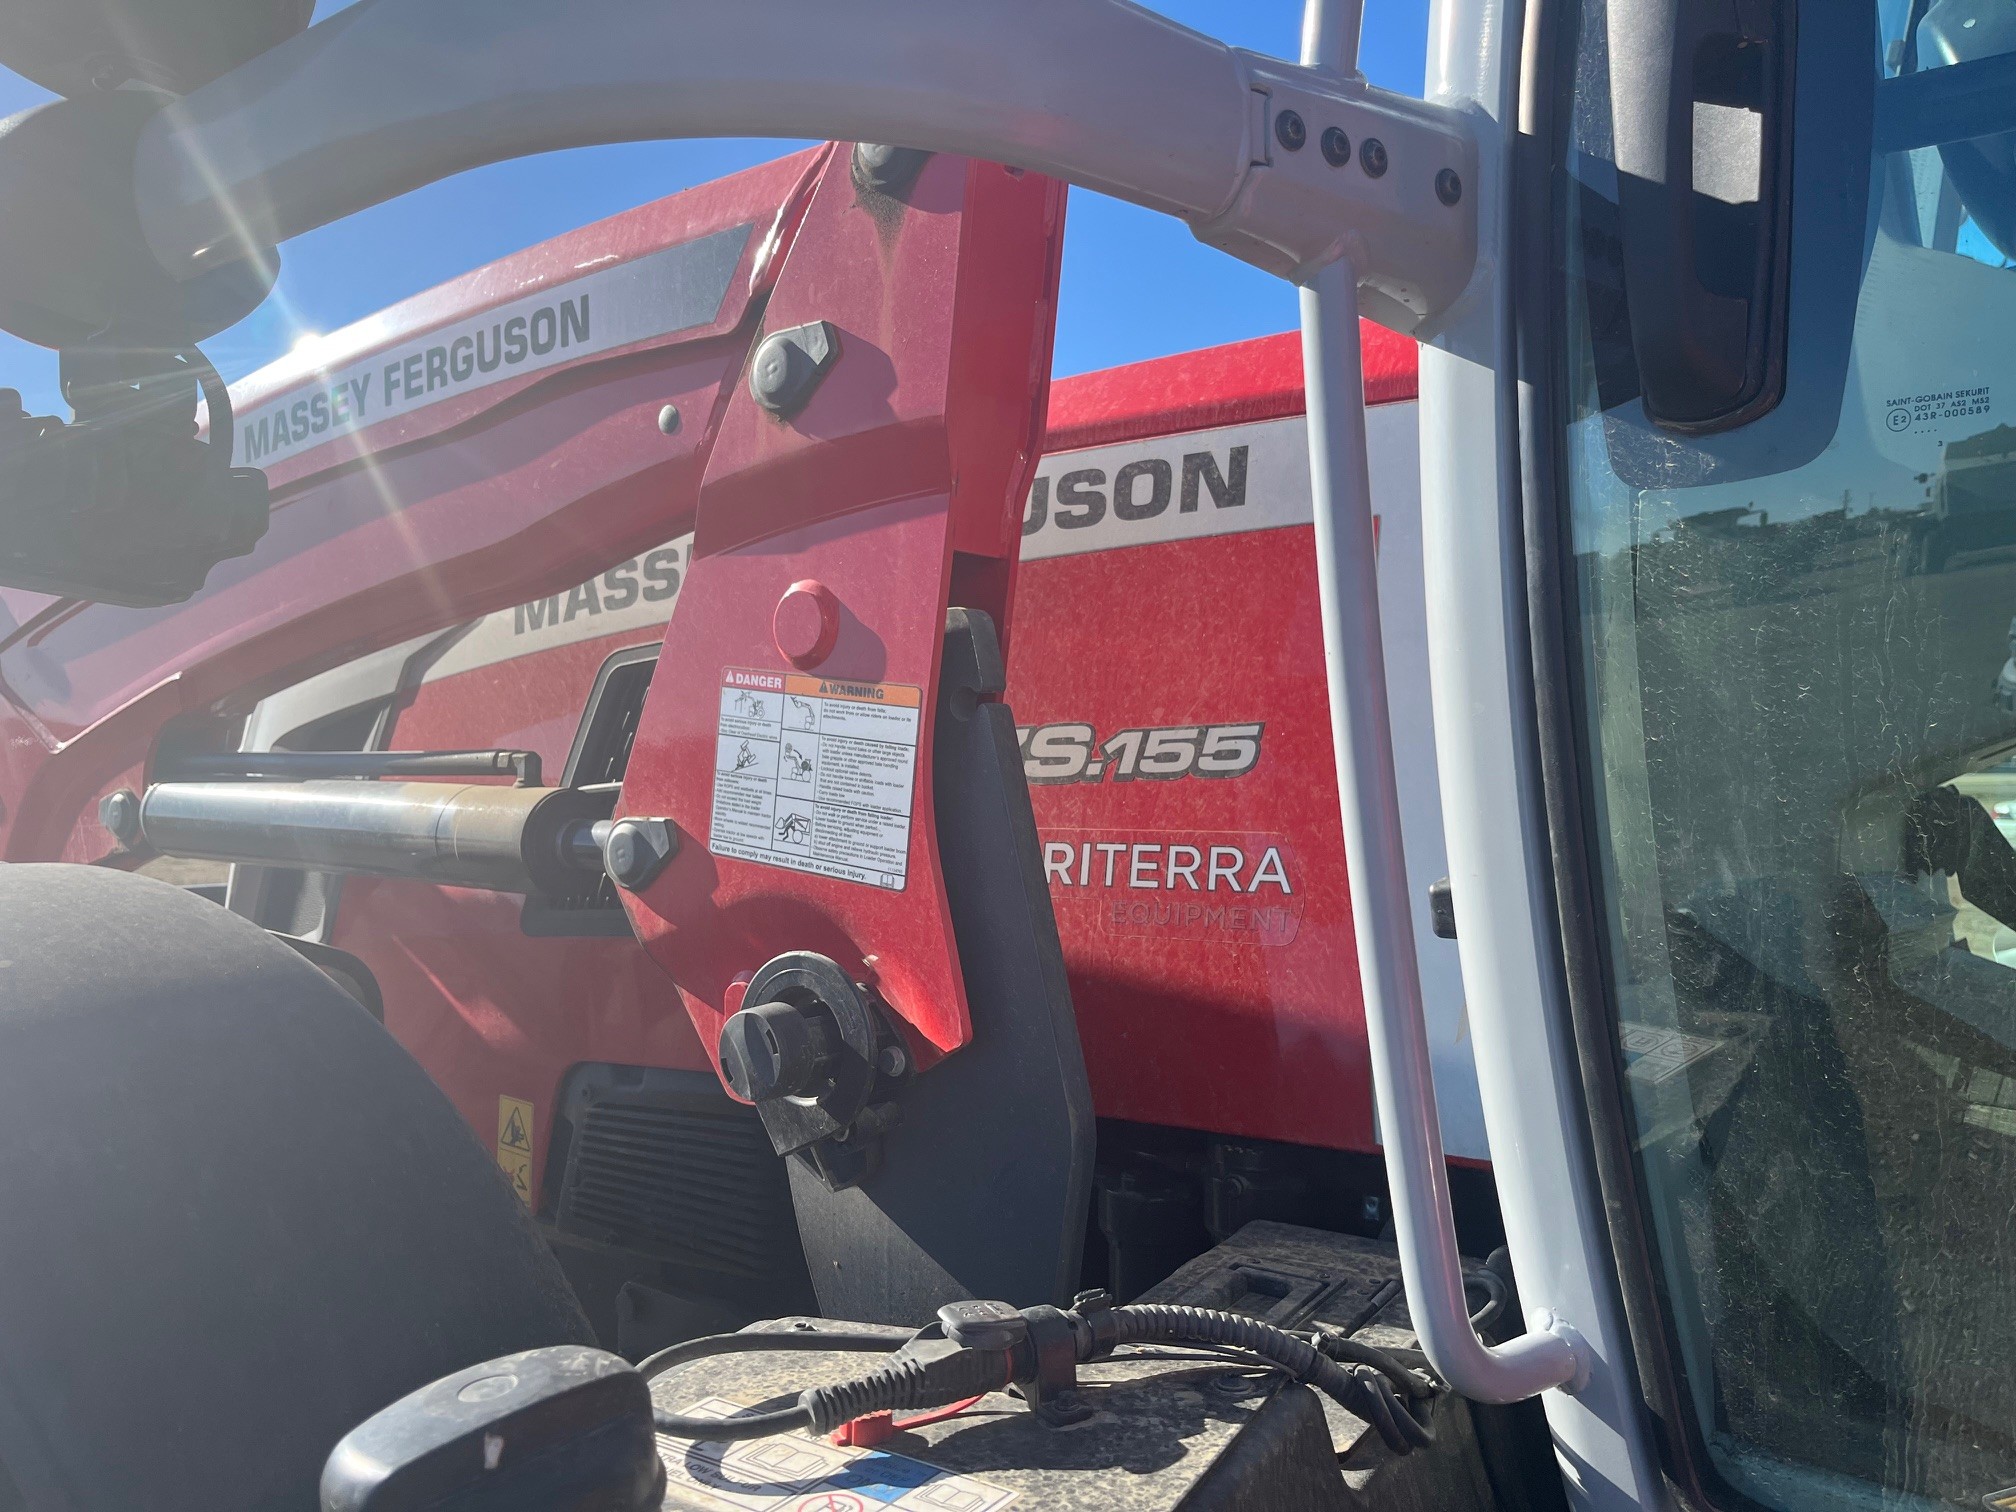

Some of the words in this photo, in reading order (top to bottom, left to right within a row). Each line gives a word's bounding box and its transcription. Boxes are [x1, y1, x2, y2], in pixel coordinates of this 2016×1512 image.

[244, 372, 371, 463] MASSEY
[383, 294, 590, 407] FERGUSON
[1886, 392, 1953, 407] SAINT-GOBAIN
[1955, 387, 1990, 399] SEKURIT
[1914, 404, 1931, 412] DOT
[1936, 402, 1946, 410] 37
[1914, 405, 1990, 421] 43R-000589
[1021, 444, 1249, 536] USON
[514, 543, 693, 636] MASS
[735, 672, 782, 689] DANGER
[829, 683, 884, 700] WARNING
[711, 842, 730, 852] Failure
[738, 848, 757, 858] comply
[758, 853, 771, 861] may
[772, 854, 789, 864] result
[797, 859, 814, 869] death
[823, 865, 846, 875] serious
[1042, 841, 1294, 896] RITERRA
[1110, 900, 1293, 935] EQUIPMENT
[685, 1461, 712, 1474] LOW
